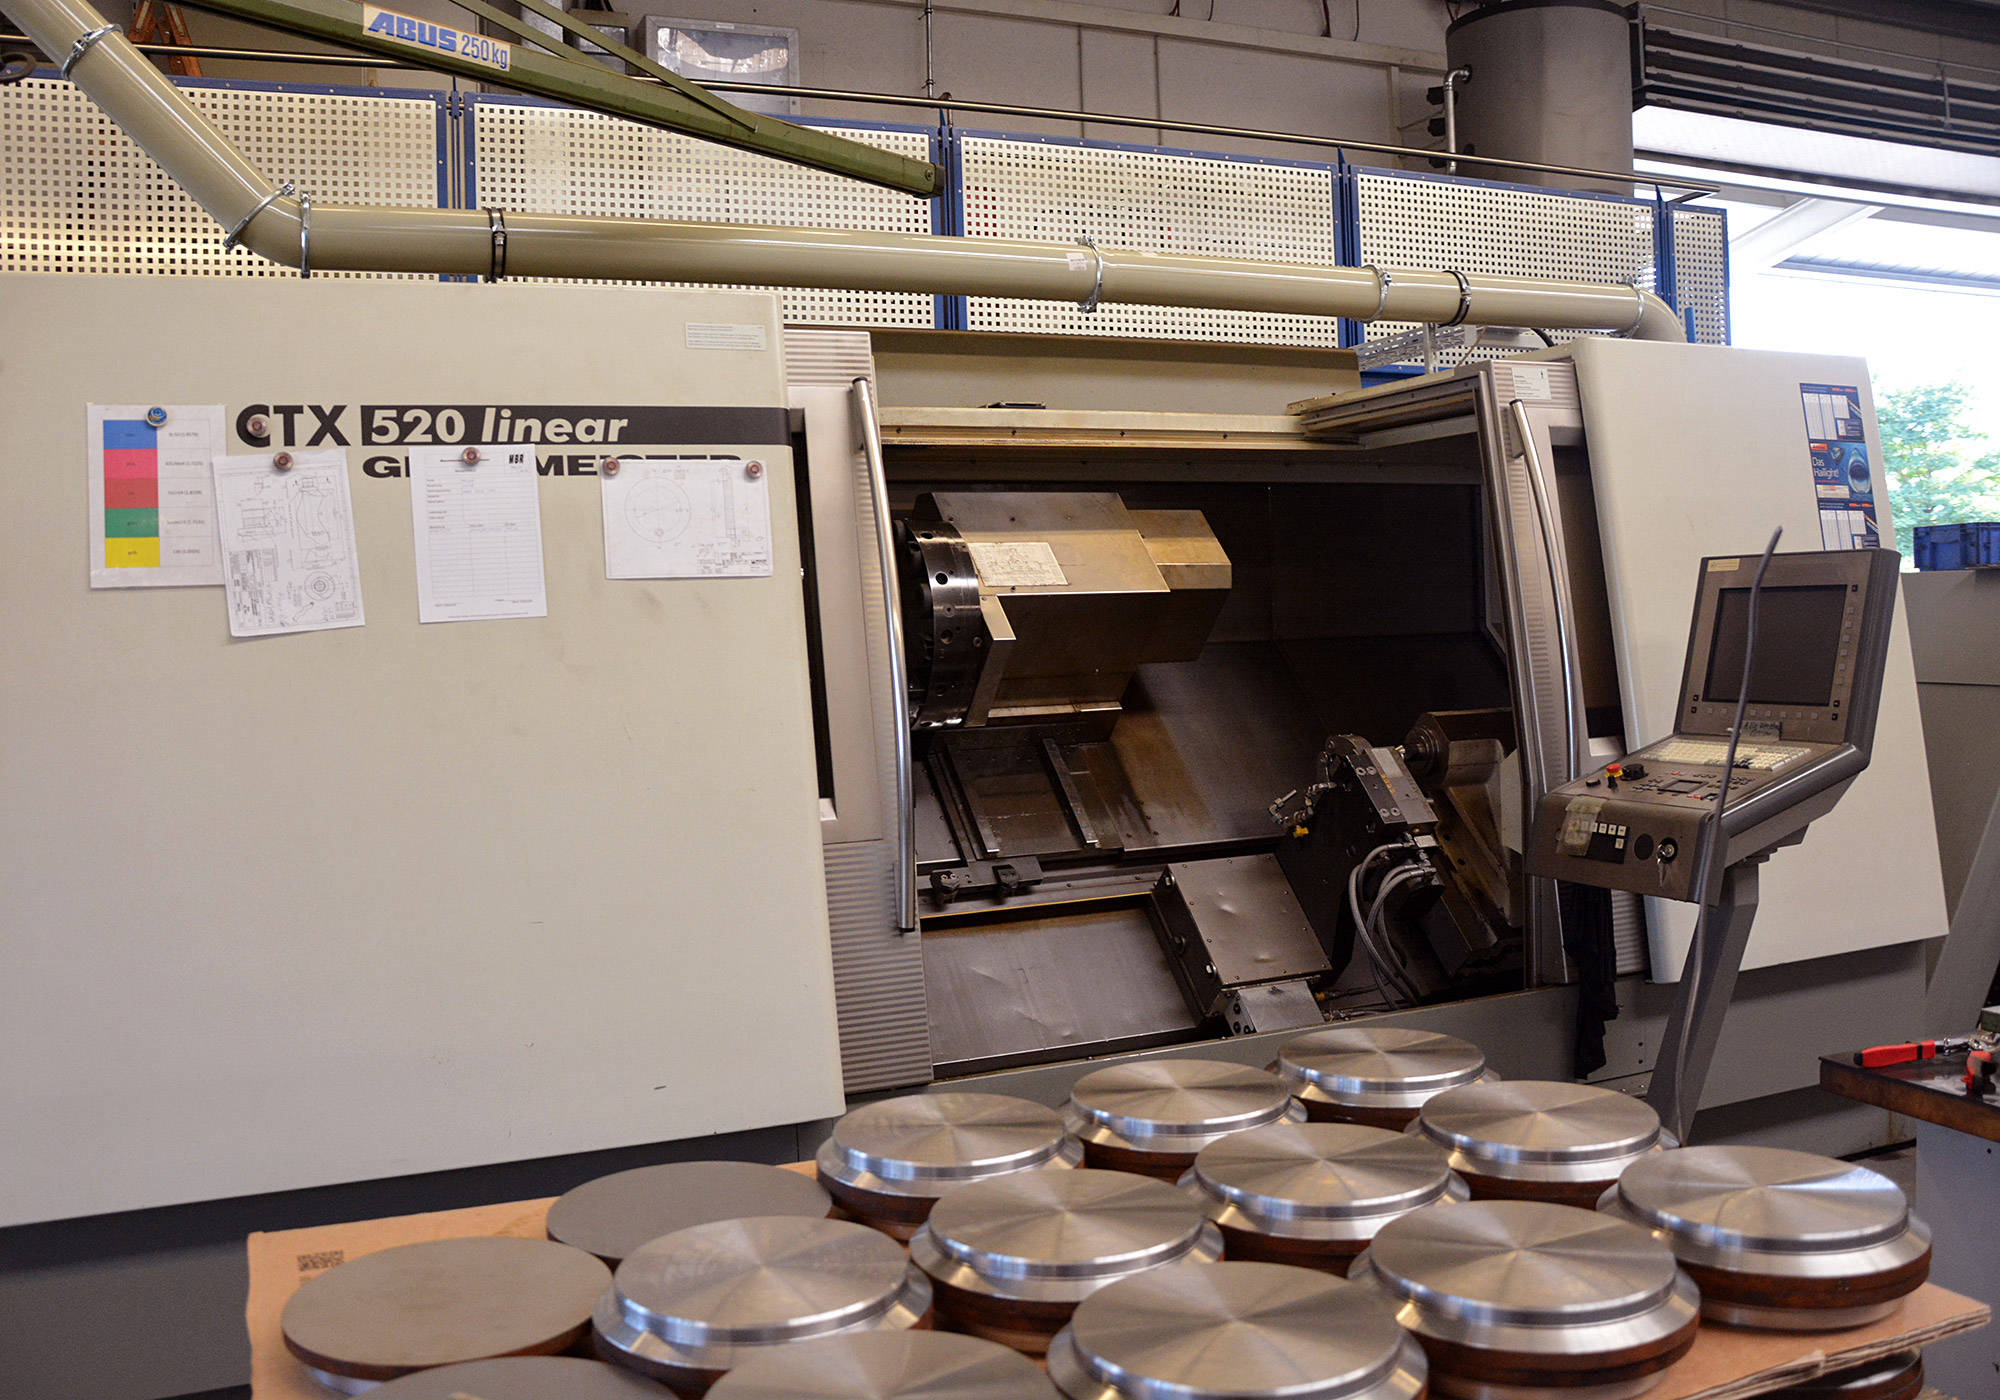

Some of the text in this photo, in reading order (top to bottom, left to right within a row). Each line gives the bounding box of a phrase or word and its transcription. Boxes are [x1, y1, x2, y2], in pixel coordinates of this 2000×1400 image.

[368, 11, 456, 52] ABUS
[236, 404, 629, 448] CTX 520 linear
